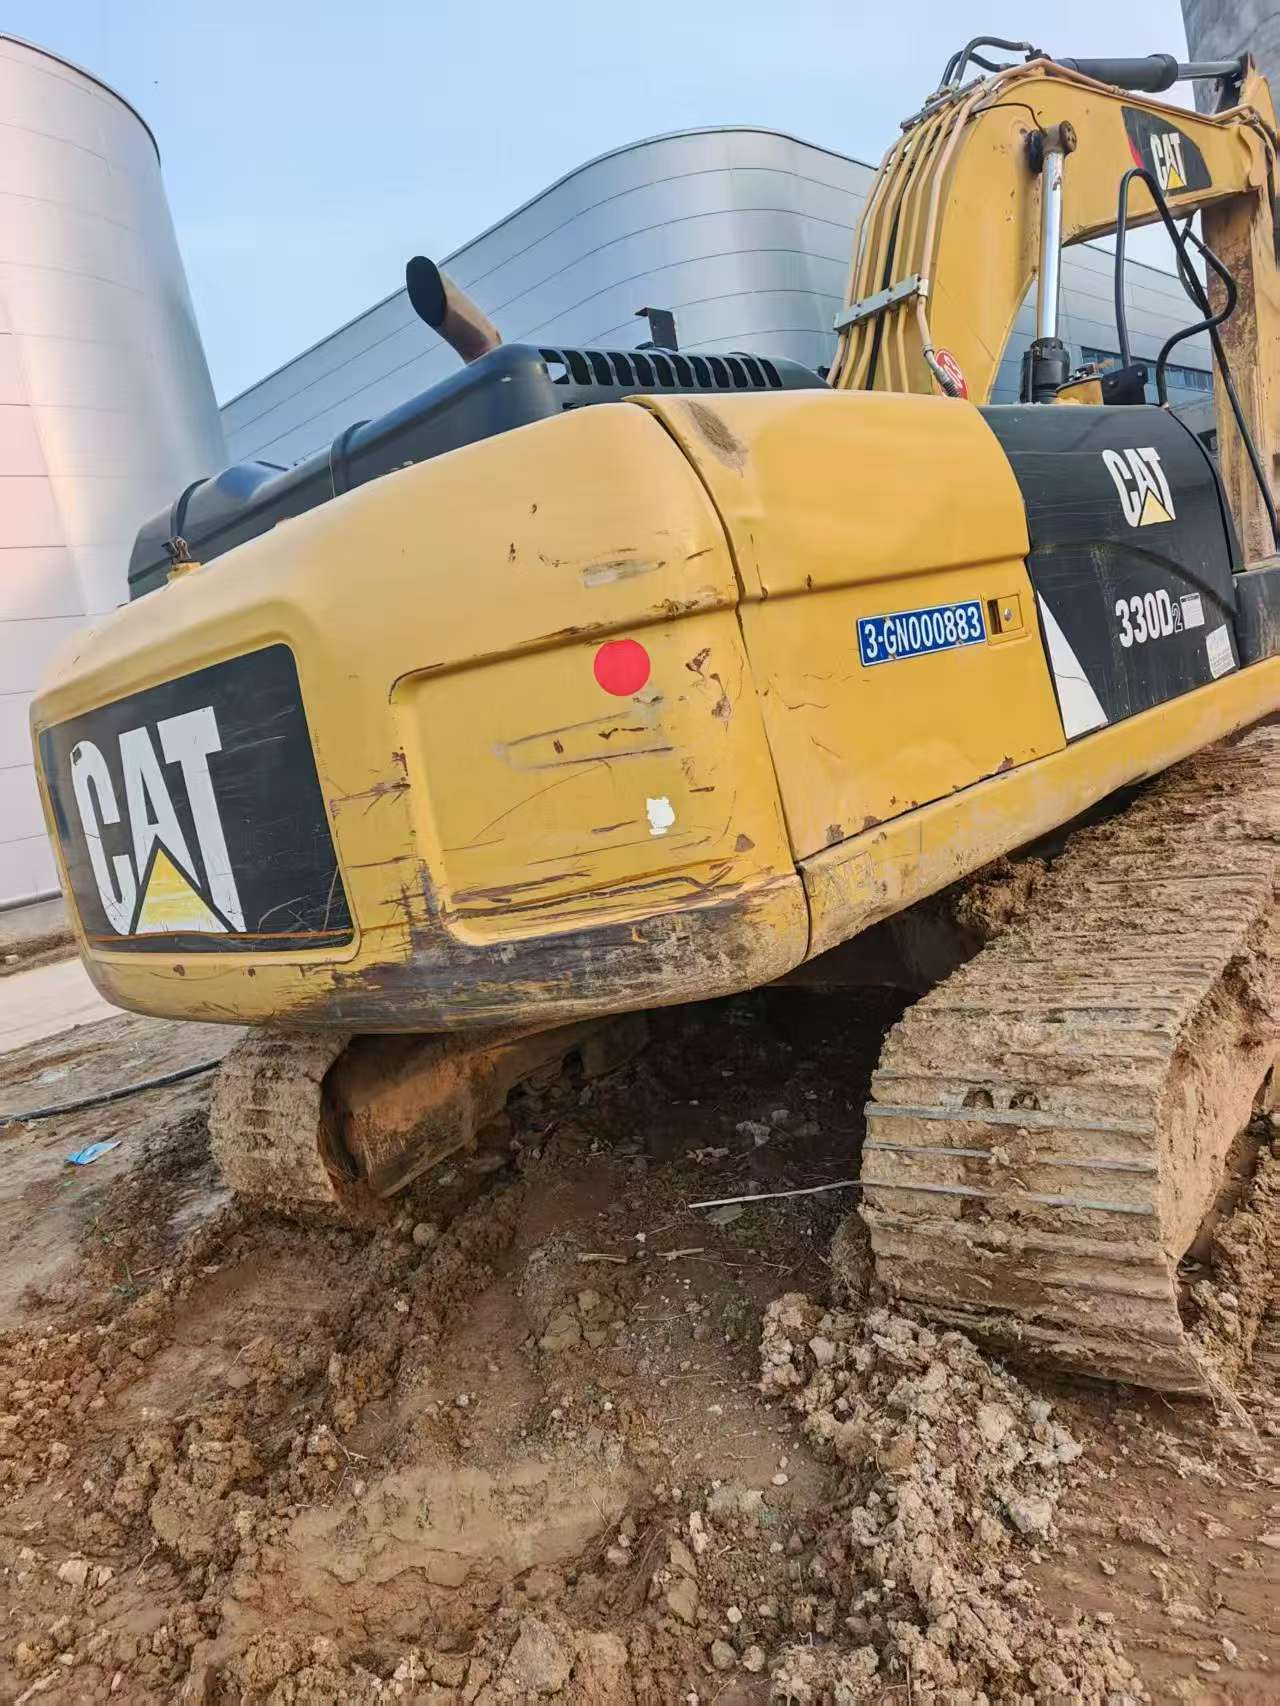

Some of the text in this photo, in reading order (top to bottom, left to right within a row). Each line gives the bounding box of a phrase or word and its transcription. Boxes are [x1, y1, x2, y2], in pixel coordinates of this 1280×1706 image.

[1150, 132, 1187, 190] CAT
[1102, 447, 1176, 527] CAT
[864, 606, 981, 658] 3-GN000883
[70, 705, 248, 936] CAT
